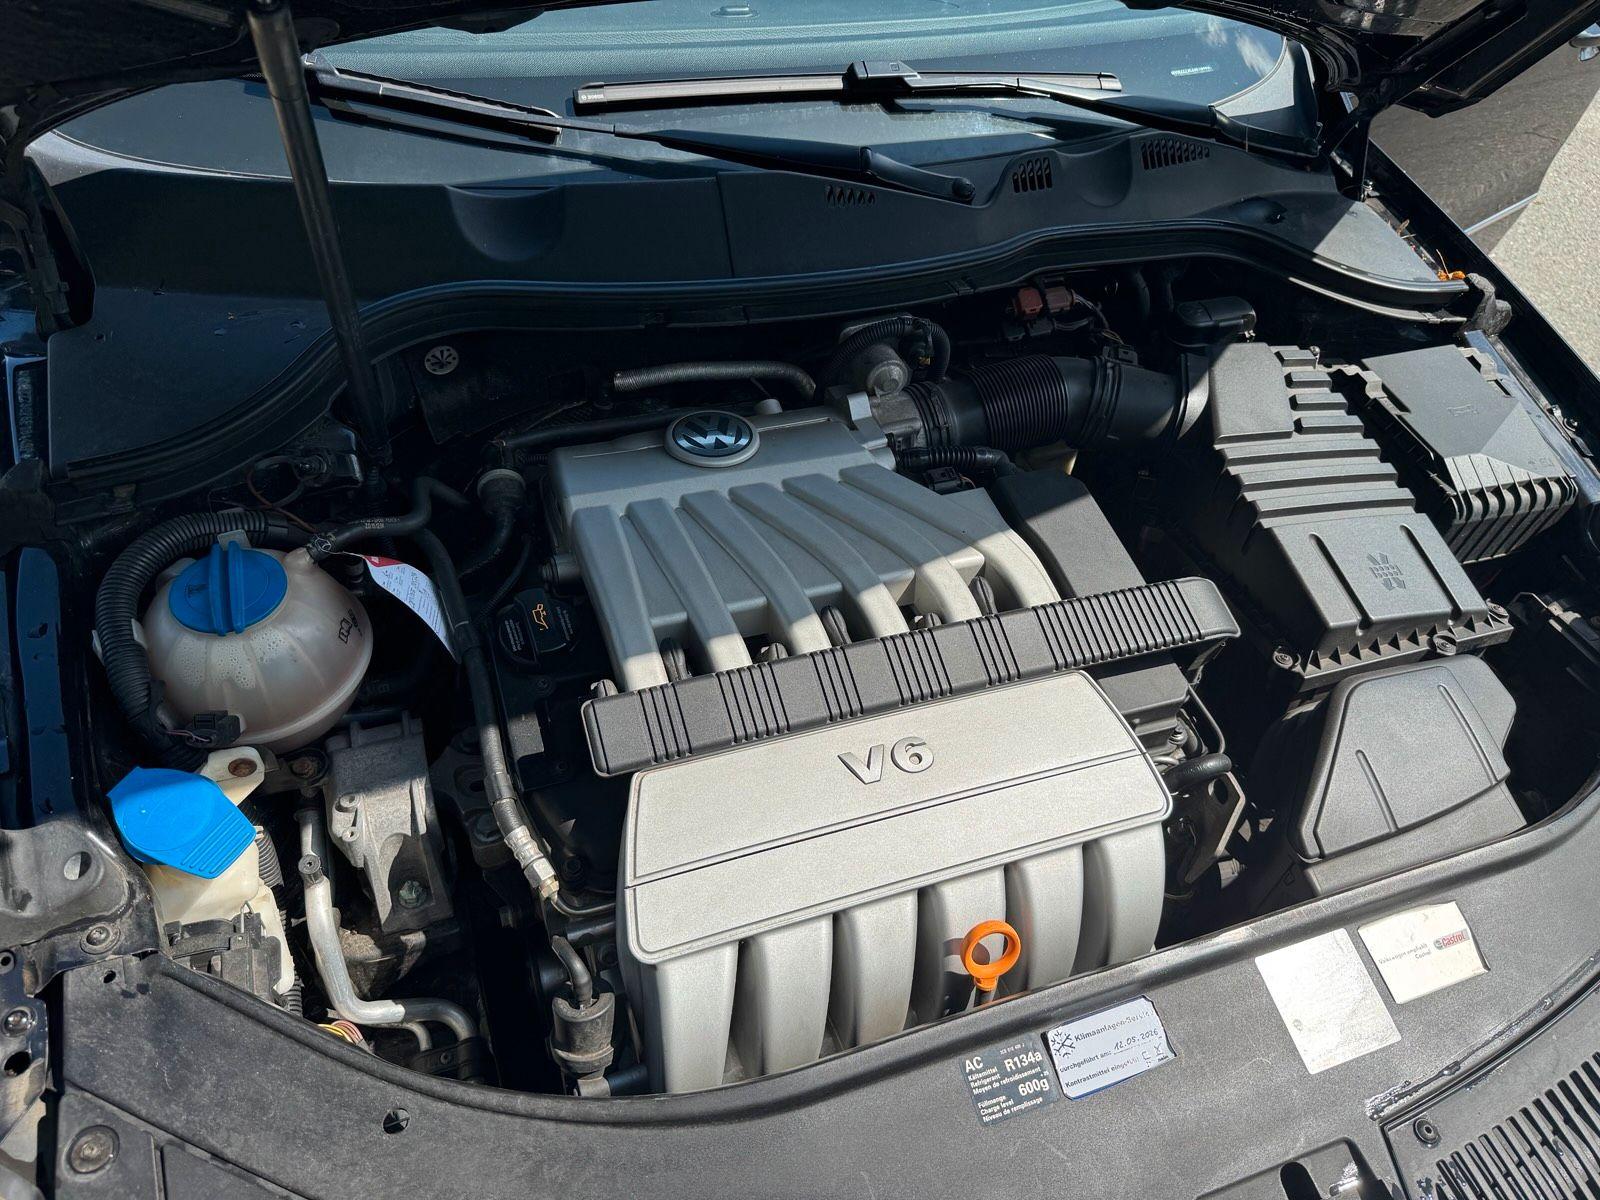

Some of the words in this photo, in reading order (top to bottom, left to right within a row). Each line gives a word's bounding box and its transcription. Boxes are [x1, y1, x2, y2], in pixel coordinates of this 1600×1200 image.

[837, 736, 934, 785] V6
[1441, 931, 1466, 948] Castrol
[965, 1056, 984, 1073] AC
[1004, 1050, 1043, 1072] R134a
[970, 1074, 1000, 1089] Refrigerant
[973, 1084, 991, 1096] Moyen
[993, 1081, 1000, 1090] de
[1000, 1067, 1041, 1085] refroidissement
[1018, 1078, 1049, 1096] 600g
[1064, 1068, 1110, 1088] Kontrastmittel
[980, 1103, 1000, 1116] Charge
[1001, 1099, 1014, 1109] level
[1004, 1108, 1010, 1117] de
[1011, 1097, 1043, 1114] remplissage
